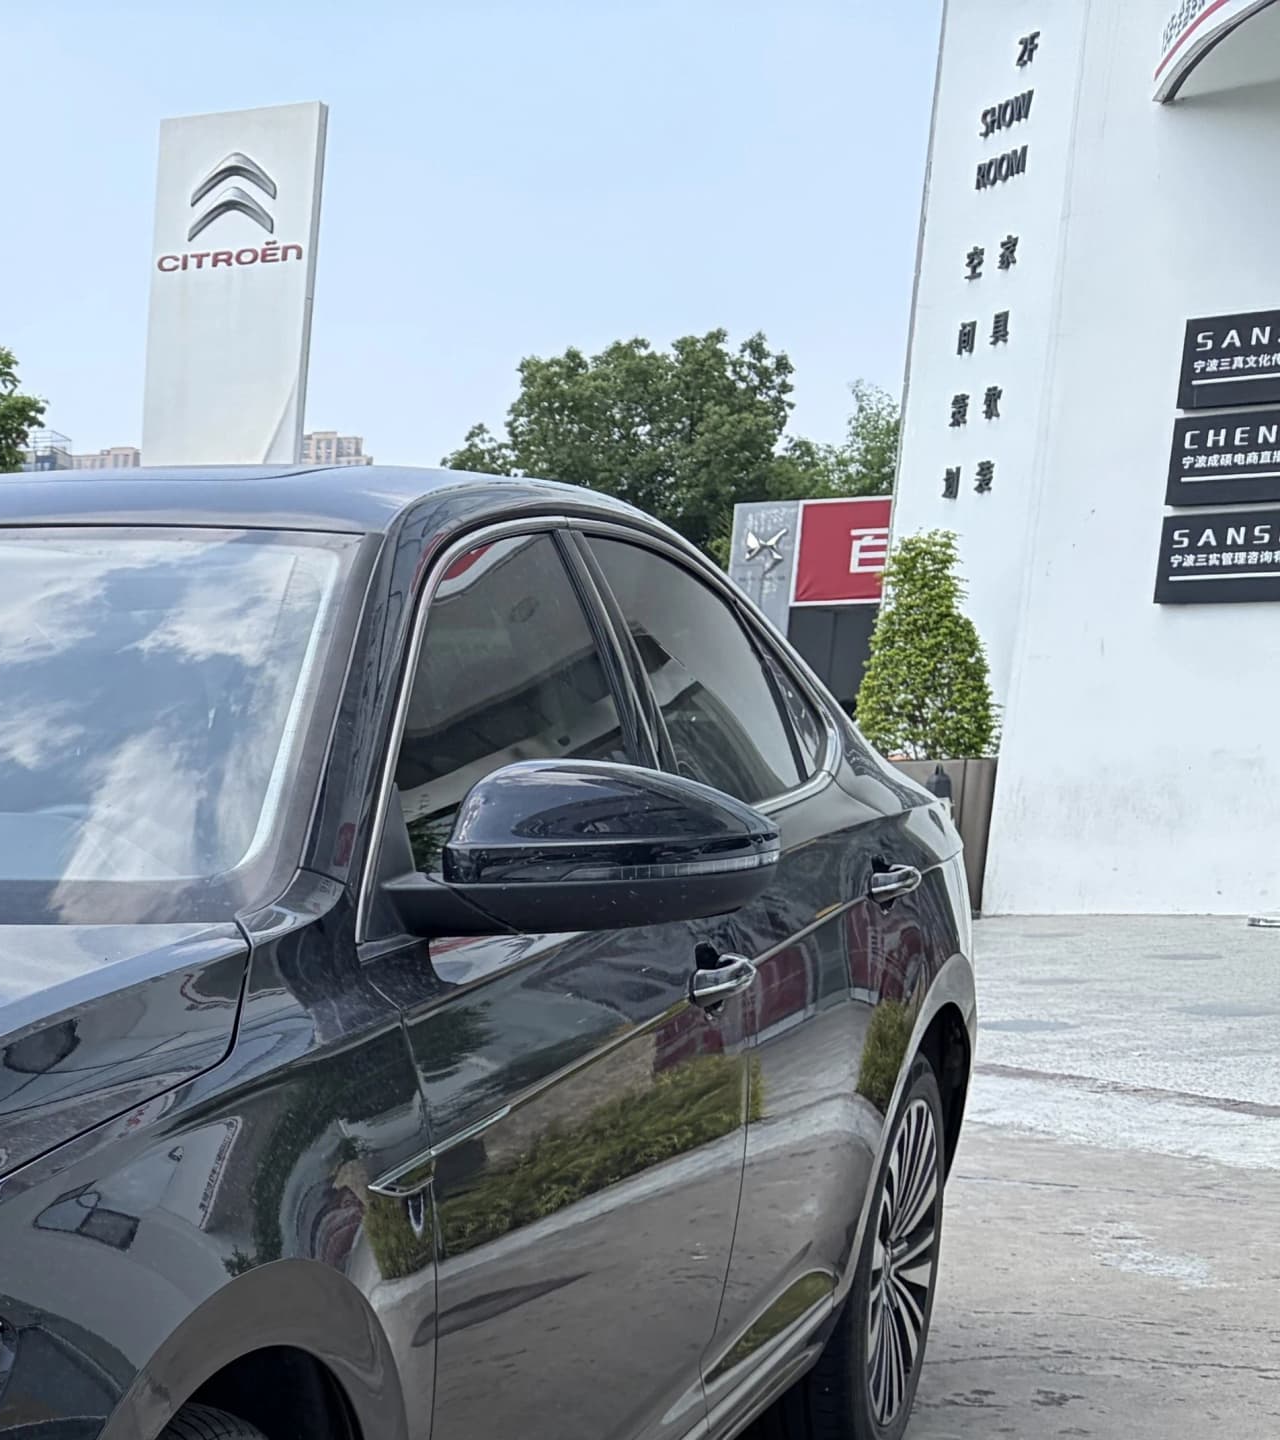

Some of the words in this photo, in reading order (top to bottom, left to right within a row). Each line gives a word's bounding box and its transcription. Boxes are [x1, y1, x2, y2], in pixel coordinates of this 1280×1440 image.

[1016, 31, 1040, 67] 2F
[979, 88, 1034, 138] SHOW
[975, 145, 1028, 190] ROOM
[1196, 326, 1280, 351] SAN
[1184, 425, 1278, 449] CHEN
[1172, 525, 1280, 548] SANS
